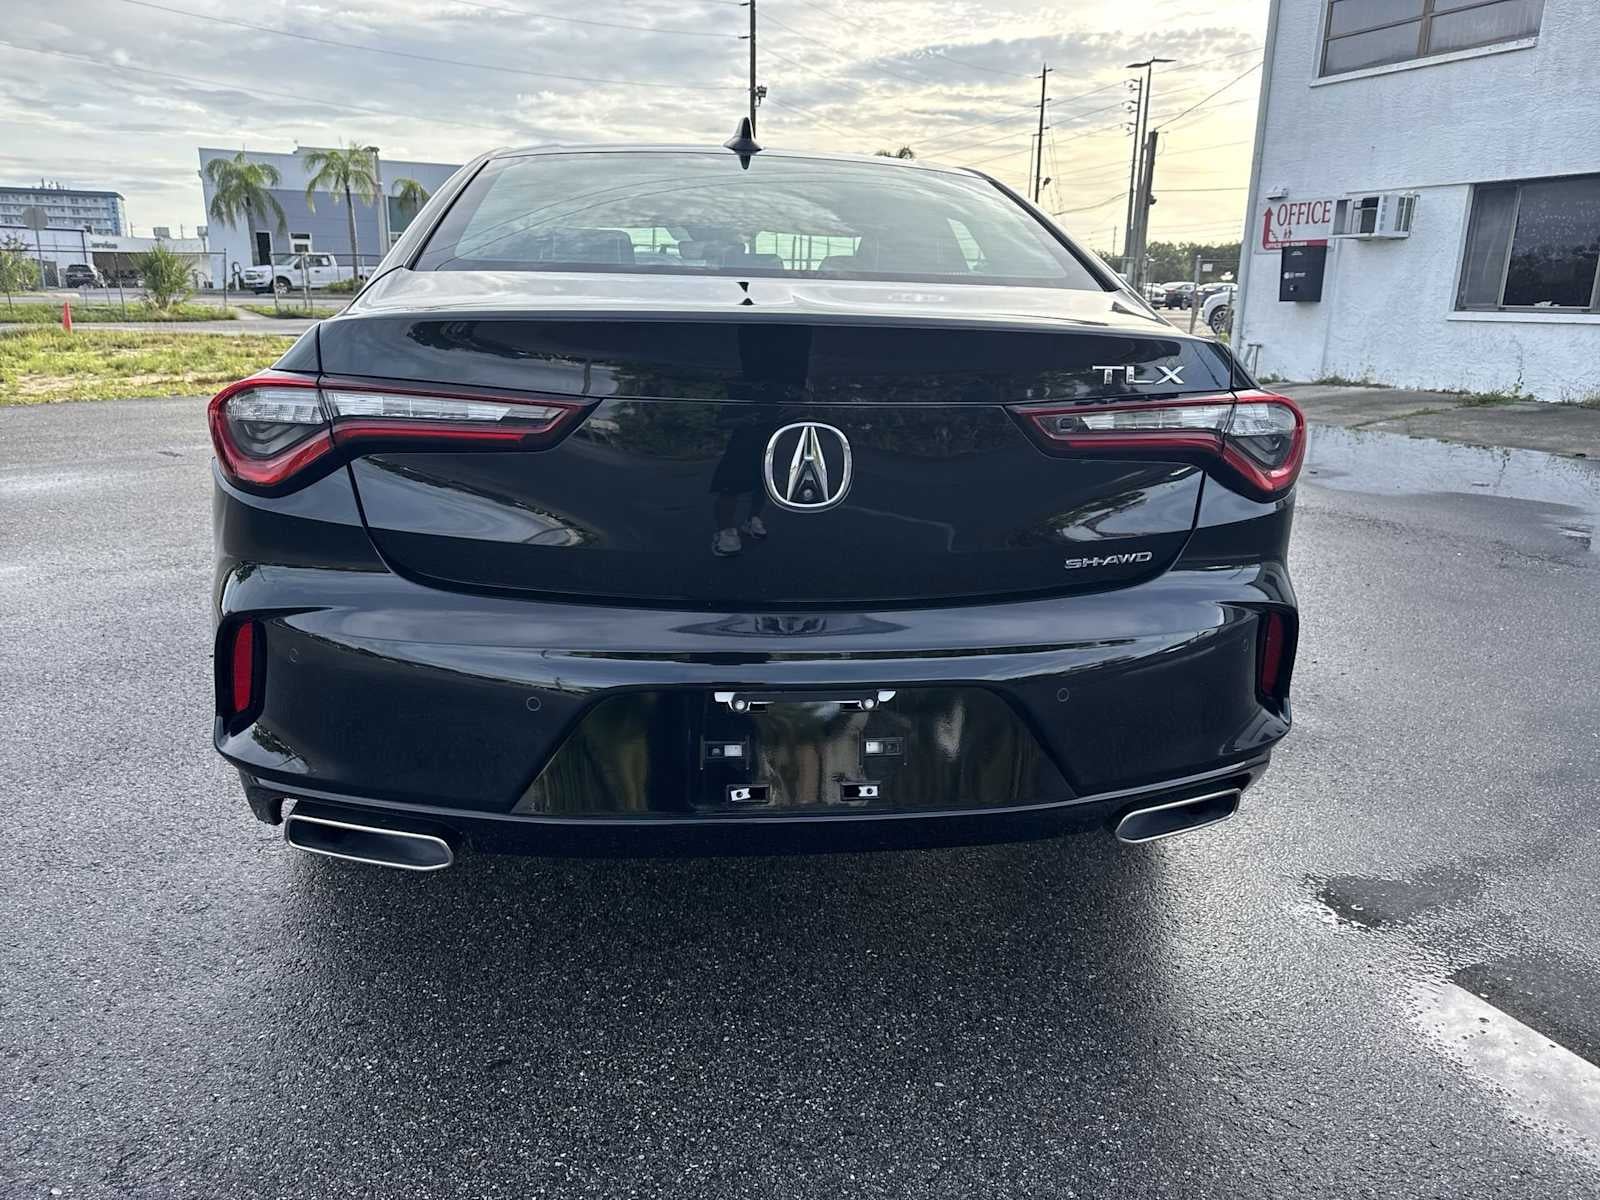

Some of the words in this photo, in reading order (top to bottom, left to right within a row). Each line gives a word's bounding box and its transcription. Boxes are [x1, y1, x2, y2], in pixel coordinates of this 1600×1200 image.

[1277, 200, 1333, 227] OFFICE
[1092, 365, 1185, 385] TLX
[1064, 551, 1153, 569] SH-AWD
